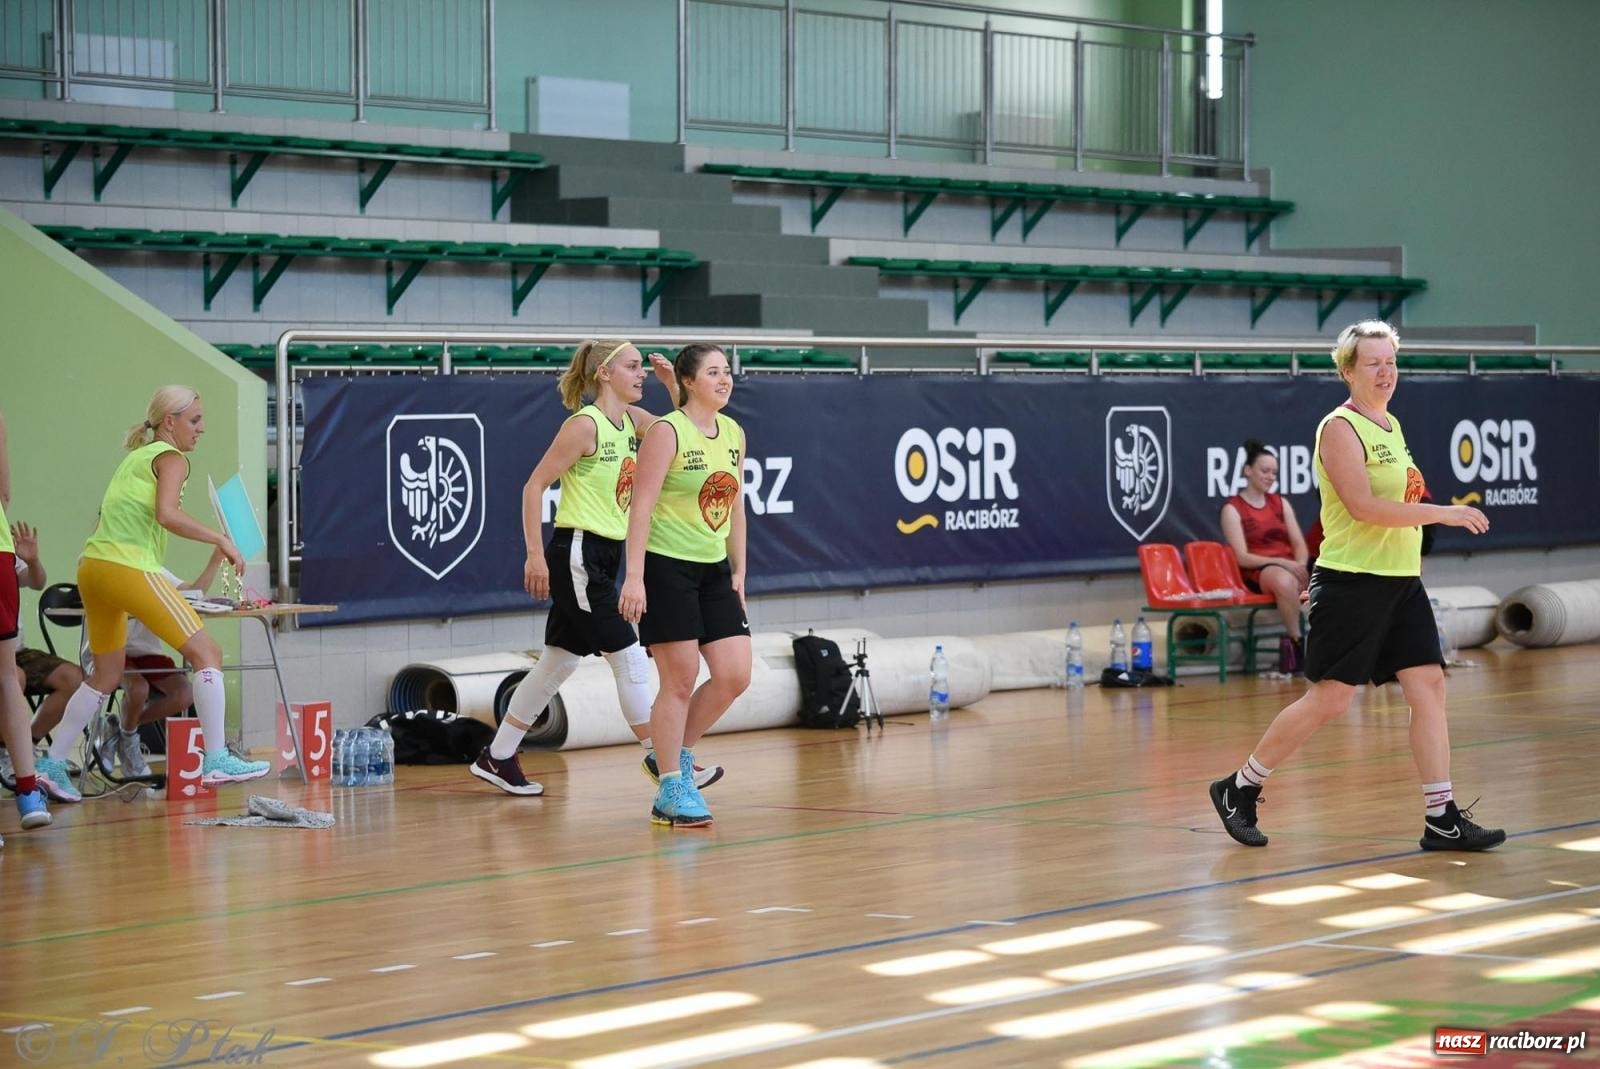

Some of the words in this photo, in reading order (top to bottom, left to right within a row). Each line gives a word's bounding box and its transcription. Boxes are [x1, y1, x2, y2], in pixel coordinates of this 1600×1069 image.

[895, 427, 1019, 503] OSiR
[1450, 419, 1538, 483] OSiR
[945, 503, 1020, 531] RACIBÓRZ
[1485, 484, 1538, 506] RACIBÓRZ
[179, 728, 205, 780] 5
[310, 710, 328, 760] 5
